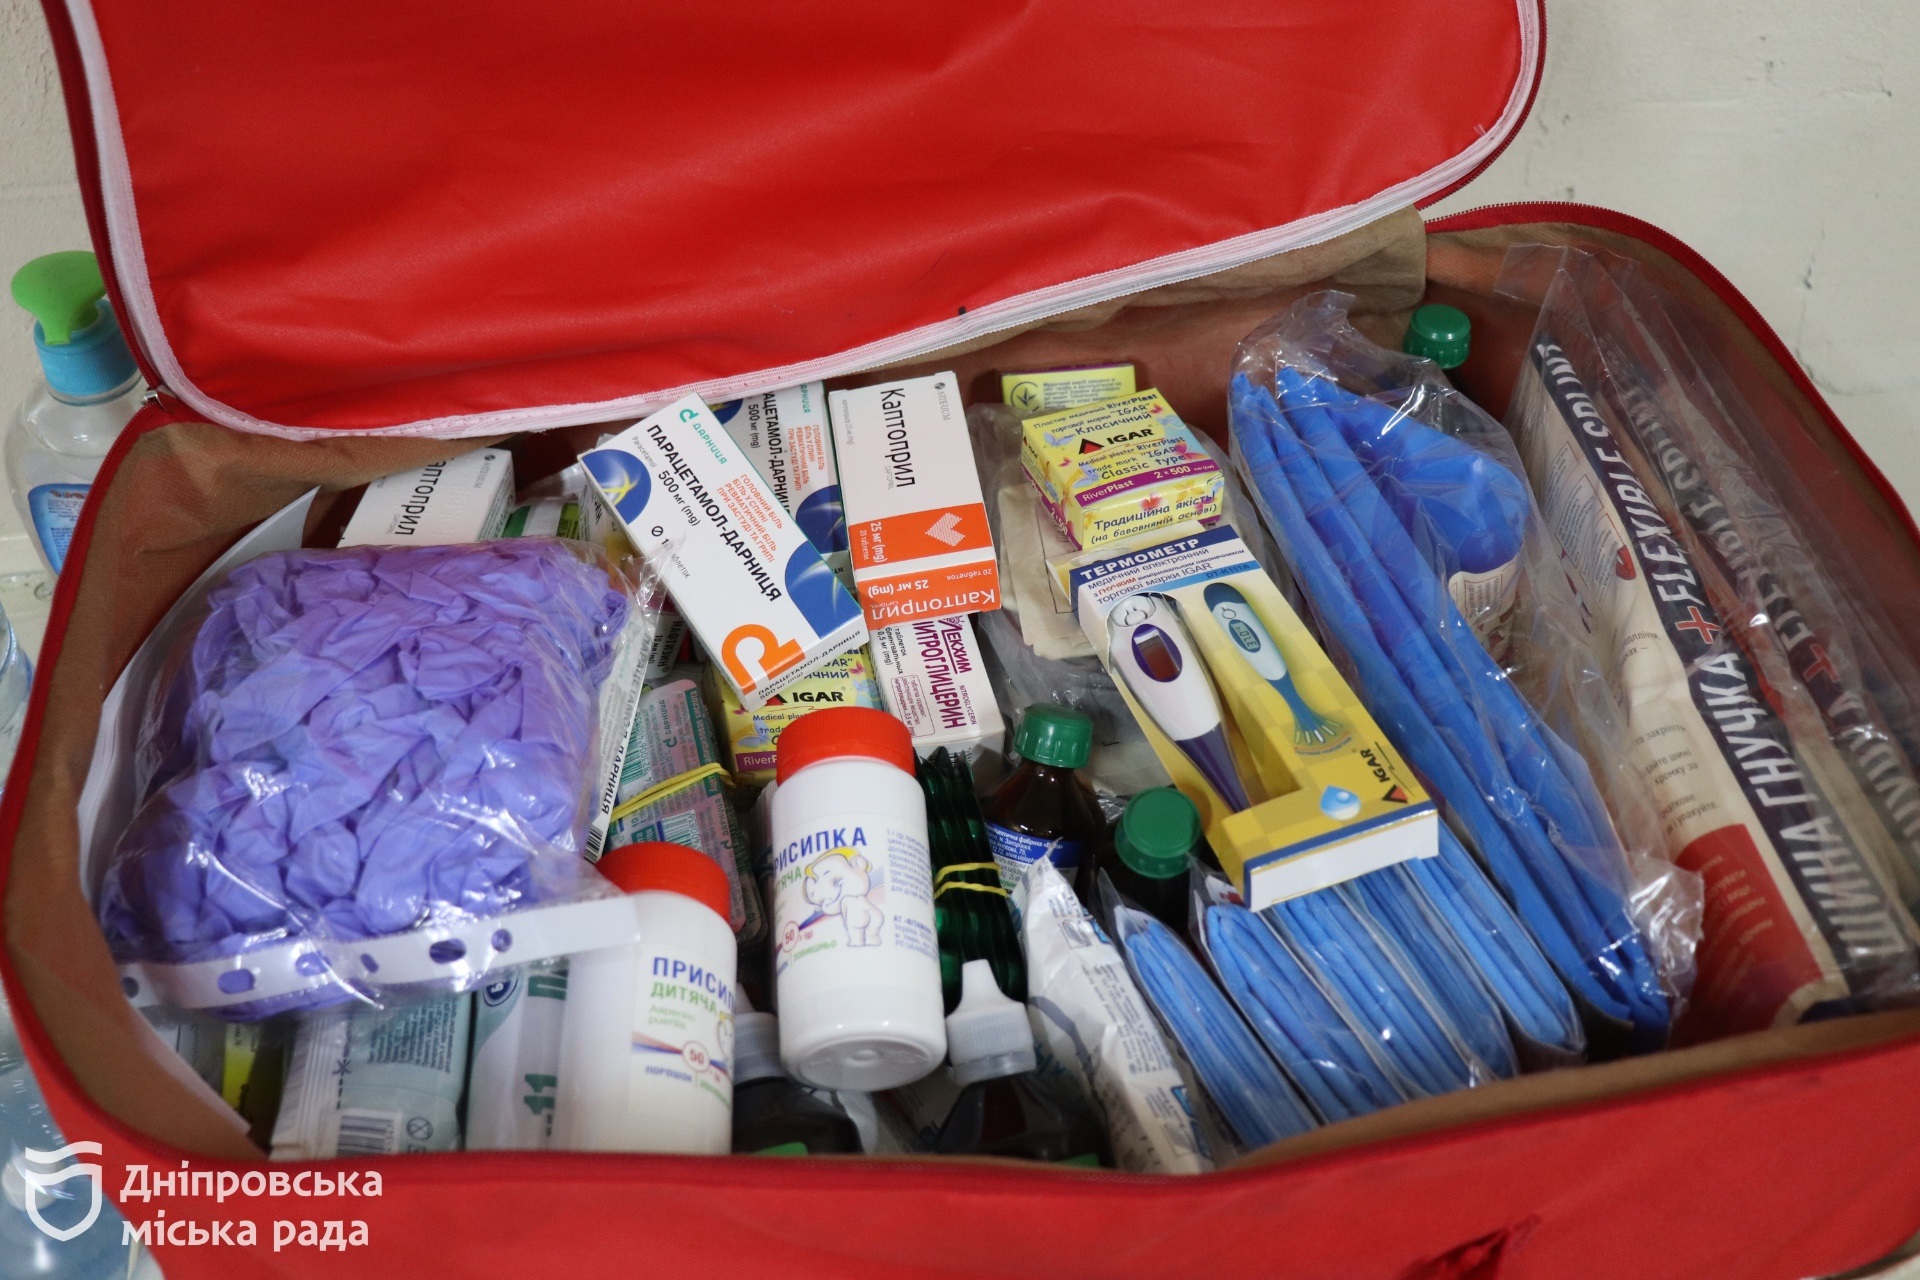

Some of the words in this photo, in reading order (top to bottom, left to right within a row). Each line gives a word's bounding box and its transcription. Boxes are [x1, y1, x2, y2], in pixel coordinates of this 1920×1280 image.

[749, 403, 760, 420] 500
[800, 384, 811, 413] АРНИЦЯ
[937, 391, 951, 421] ARTERIUM
[1107, 393, 1158, 409] RiverPlast
[750, 422, 759, 431] мг
[804, 425, 812, 439] БІЛЬ
[880, 388, 916, 488] Каптоприл
[1075, 411, 1152, 435] Класичний
[1107, 428, 1154, 445] IGAR
[631, 436, 657, 470] Paracetamol
[693, 423, 727, 465] ДАРНИЦЯ
[749, 432, 761, 449] (mg)
[763, 391, 791, 514] АЦЕТАМОЛ-ДАРНИЦ
[807, 444, 815, 463] СПИНІ
[812, 424, 824, 456] ГОЛОВНИЙ
[818, 456, 826, 471] БІЛЬ
[1078, 455, 1107, 468] Medical
[1109, 448, 1135, 458] plaster
[1136, 437, 1185, 450] RiverPlast
[788, 441, 798, 464] ЗАСТУДІ
[794, 471, 802, 491] ГРИПІ
[796, 427, 808, 469] РЕВМАТИЧНИЙ
[802, 469, 811, 485] БІЛЬ
[1088, 464, 1112, 475] trade
[1115, 457, 1137, 466] mark
[1101, 462, 1150, 480] Classic
[1155, 454, 1187, 466] type
[395, 459, 447, 536] аптоприл
[658, 470, 680, 493] 500
[673, 493, 686, 505] мг
[681, 505, 701, 527] (mg)
[1082, 480, 1134, 502] RiverPlast
[1154, 471, 1163, 479] 2
[1169, 465, 1191, 475] 500
[647, 424, 782, 602] ПАРАЦЕТАМОЛ-ДАРНИЦЯ
[732, 478, 747, 496] БІЛЬ
[749, 500, 768, 523] СПИНІ
[740, 473, 772, 513] ГОЛОВНИЙ
[768, 511, 784, 530] БІЛЬ
[716, 487, 731, 503] ПРИ
[728, 502, 753, 532] ЗАСТУДІ
[750, 531, 759, 542] ТА
[756, 541, 775, 562] ГРИПІ
[724, 483, 767, 533] РЕВМАТИЧНИЙ
[762, 533, 777, 551] БІЛЬ
[870, 522, 882, 532] 25
[1091, 534, 1108, 545] (на
[1113, 515, 1173, 537] бавовняній
[1178, 503, 1217, 520] основі)
[1094, 505, 1170, 531] Традиційна
[860, 529, 867, 537] 20
[871, 533, 882, 543] мг
[861, 538, 869, 561] таблеток
[873, 544, 887, 563] (mg)
[1080, 538, 1199, 581] ТЕРМОМЕТР
[670, 552, 691, 579] аблеток
[947, 571, 982, 581] таблеток
[982, 568, 992, 576] 20
[1087, 567, 1141, 590] медичний
[1142, 548, 1210, 571] електронний
[1098, 577, 1137, 596] ГНУЧКИМ
[1137, 561, 1195, 581] вимірювальним
[1195, 549, 1245, 566] наконечником
[1206, 564, 1250, 579] DT-K111A
[868, 583, 894, 598] (mg)
[896, 582, 912, 592] мг
[915, 579, 929, 591] 25
[1097, 582, 1144, 605] торгової
[1146, 573, 1181, 588] марки
[1181, 562, 1213, 577] IGAR
[872, 589, 996, 621] Каптоприл
[877, 630, 885, 641] 0,5
[880, 641, 888, 650] мг
[885, 627, 903, 674] блингвальных
[894, 627, 907, 657] таблеток
[938, 619, 973, 674] ЛЕКХИМ
[758, 630, 861, 696] ПАРАЦЕТАМОЛ-ДАРНИЦЯ
[882, 650, 893, 666] (mg)
[759, 690, 776, 700] 500
[792, 691, 845, 703] IGAR
[959, 685, 977, 725] NITROGLYCERIN
[752, 713, 785, 722] Medical
[1698, 652, 1818, 807] ГНУЧКА
[743, 756, 777, 766] RiverP
[1360, 748, 1391, 786] IGAR
[773, 826, 867, 878] РИСИПКА
[775, 866, 802, 895] ТЯЧА
[1780, 816, 1904, 954] ШИНА
[651, 981, 718, 1015] ДИТЯЧА
[653, 957, 736, 1016] ПРИСИП
[690, 1050, 705, 1065] 50
